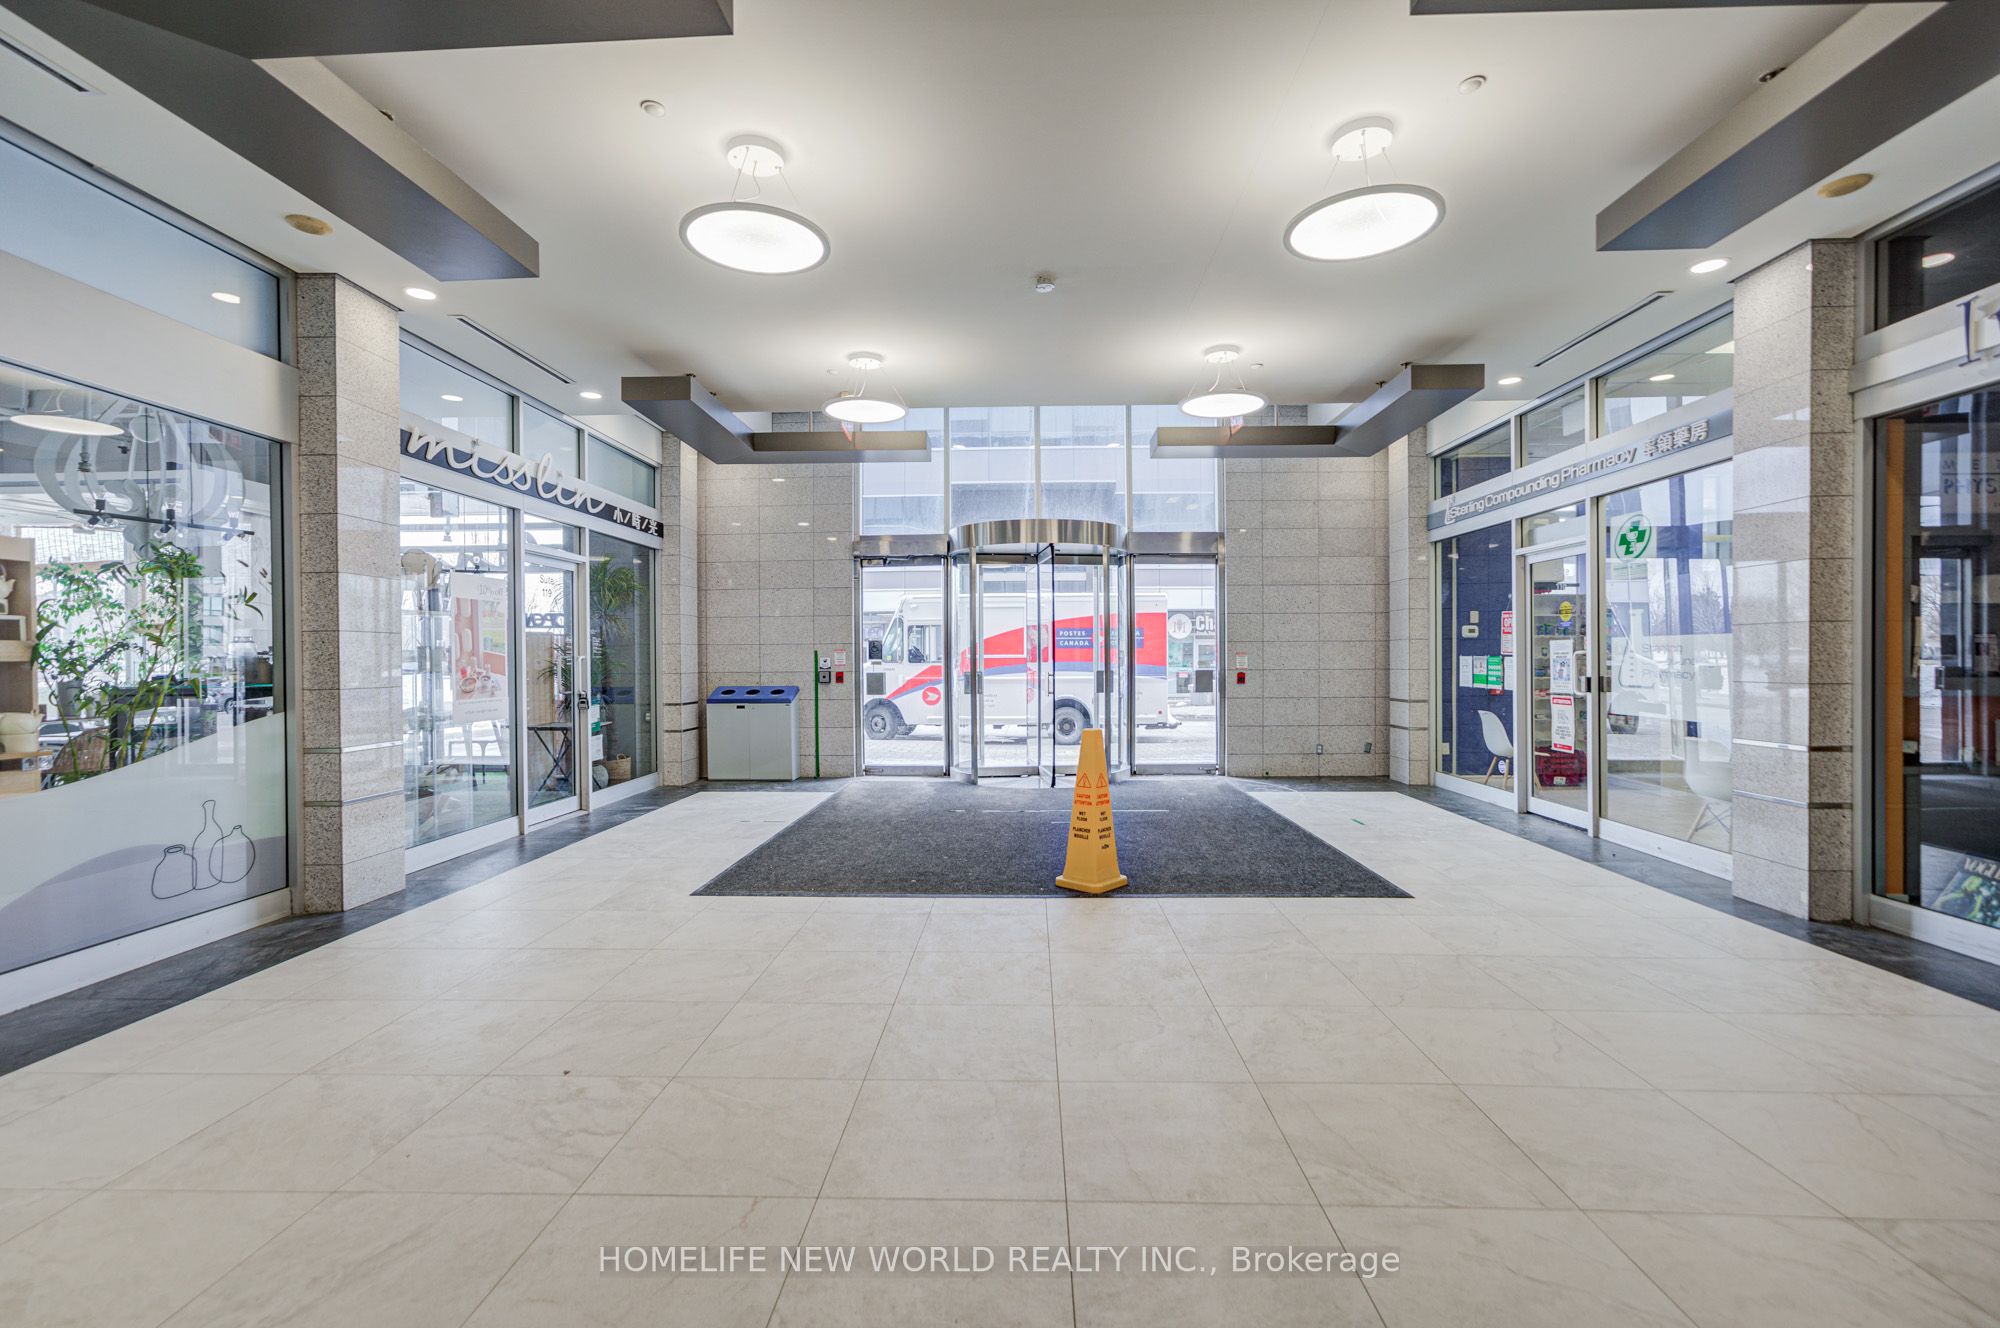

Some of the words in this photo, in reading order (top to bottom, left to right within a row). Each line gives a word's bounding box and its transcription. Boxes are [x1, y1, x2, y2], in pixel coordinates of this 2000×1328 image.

[1450, 500, 1484, 517] Sterling
[1485, 473, 1560, 507] Compounding
[1562, 448, 1637, 483] Pharmacy
